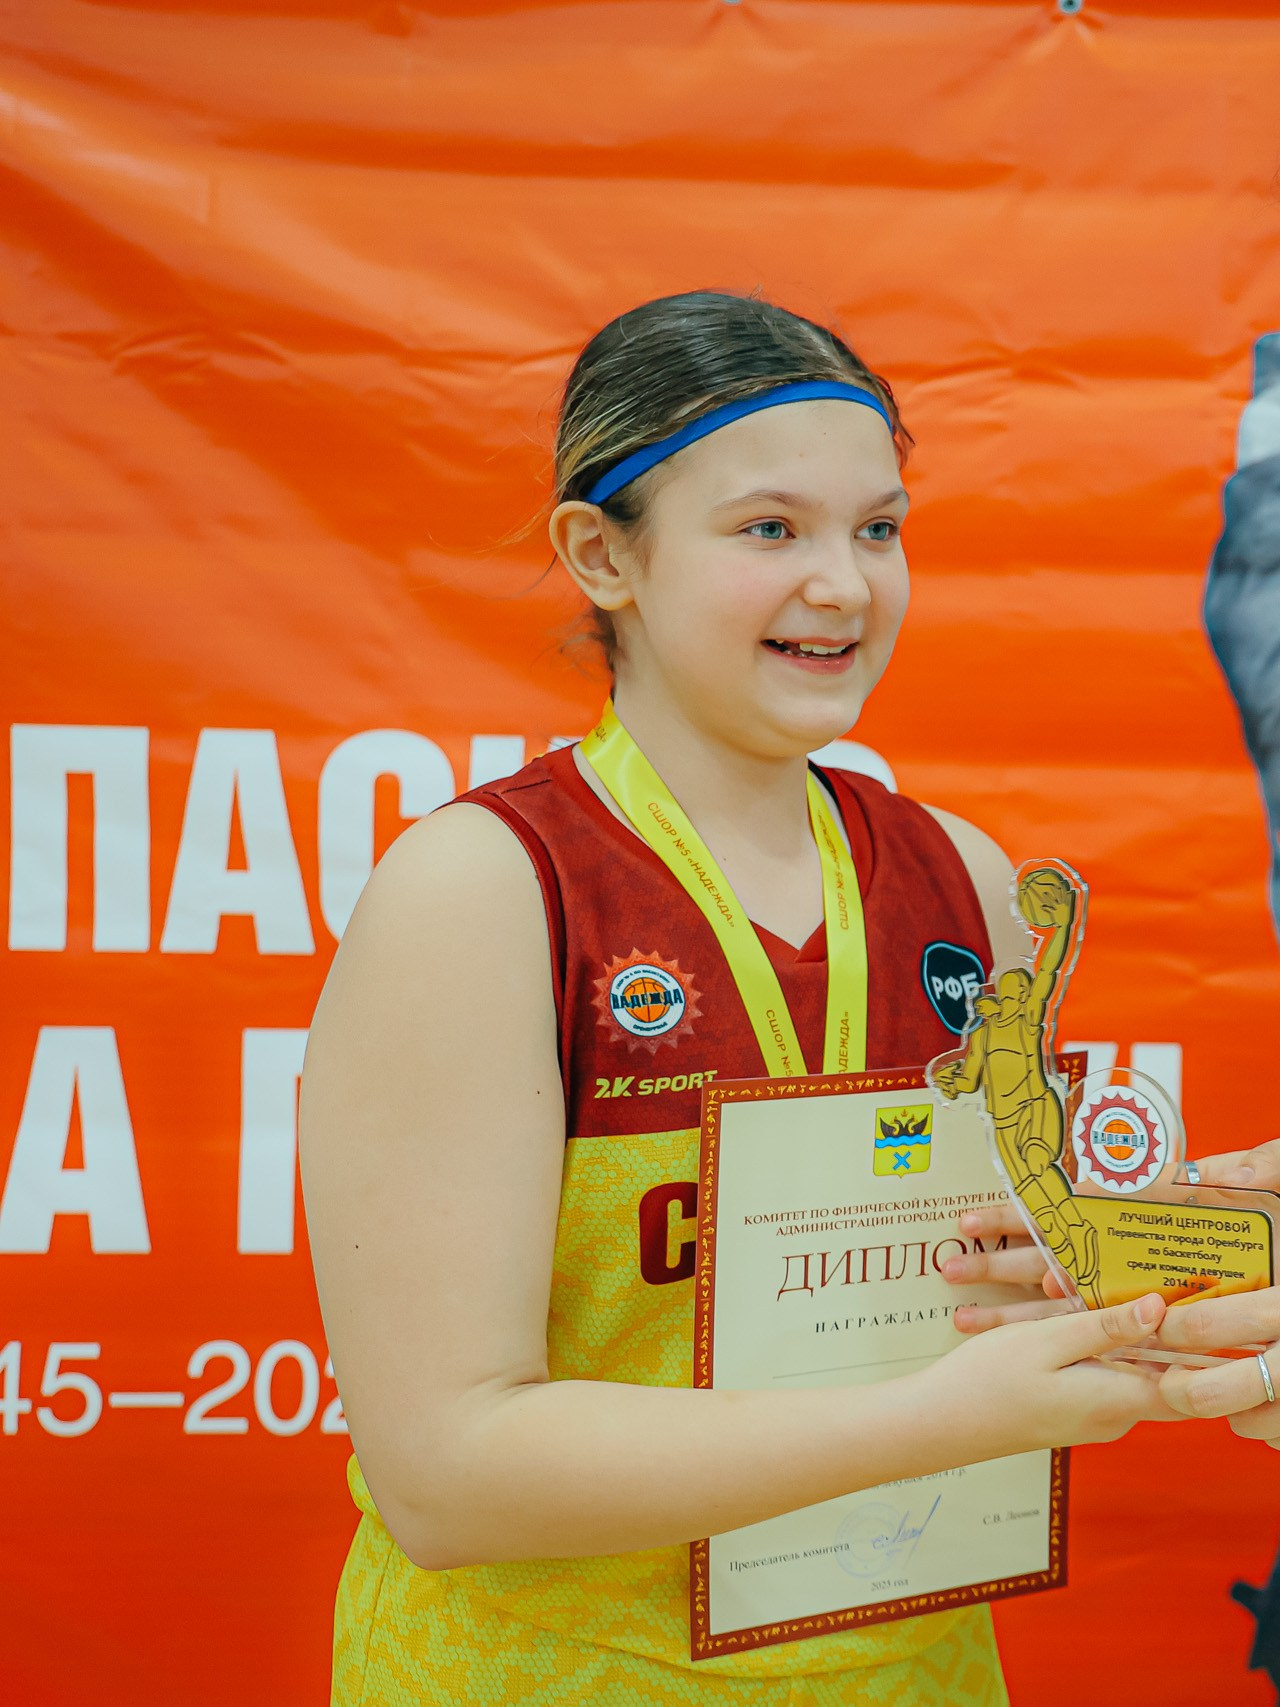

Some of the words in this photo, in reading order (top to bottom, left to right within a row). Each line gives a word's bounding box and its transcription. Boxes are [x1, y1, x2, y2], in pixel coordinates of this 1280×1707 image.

[648, 802, 677, 838] СШОР
[672, 838, 690, 858] №5
[688, 857, 735, 928] «НАДЕЖДА»
[840, 893, 850, 930] СШОР
[931, 972, 980, 1001] РФБ
[766, 1009, 787, 1052] СШОР
[637, 1070, 718, 1096] SPORT
[744, 1210, 807, 1226] КОМИТЕТ
[810, 1208, 829, 1219] ПО
[832, 1197, 920, 1217] ФИЗИЧЕСКОЙ
[923, 1192, 985, 1209] КУЛЬТУРЕ
[987, 1191, 996, 1201] И
[776, 1216, 894, 1237] АДМИНИСТРАЦИИ
[897, 1212, 945, 1225] ГОРОДА
[1118, 1212, 1172, 1227] ЛУЧШИЙ
[1176, 1218, 1251, 1233] ЦЕНТРОВОЙ
[1107, 1227, 1166, 1242] Первенства
[1168, 1234, 1204, 1246] города
[1207, 1237, 1264, 1252] Оренбурга
[1148, 1247, 1161, 1256] по
[1163, 1247, 1222, 1264] баскетболу
[1127, 1260, 1157, 1272] среди
[1159, 1263, 1197, 1276] команд
[1200, 1268, 1245, 1280] девушек
[1163, 1277, 1189, 1288] 2014
[729, 1553, 800, 1573] Председатель
[803, 1542, 850, 1559] комитета
